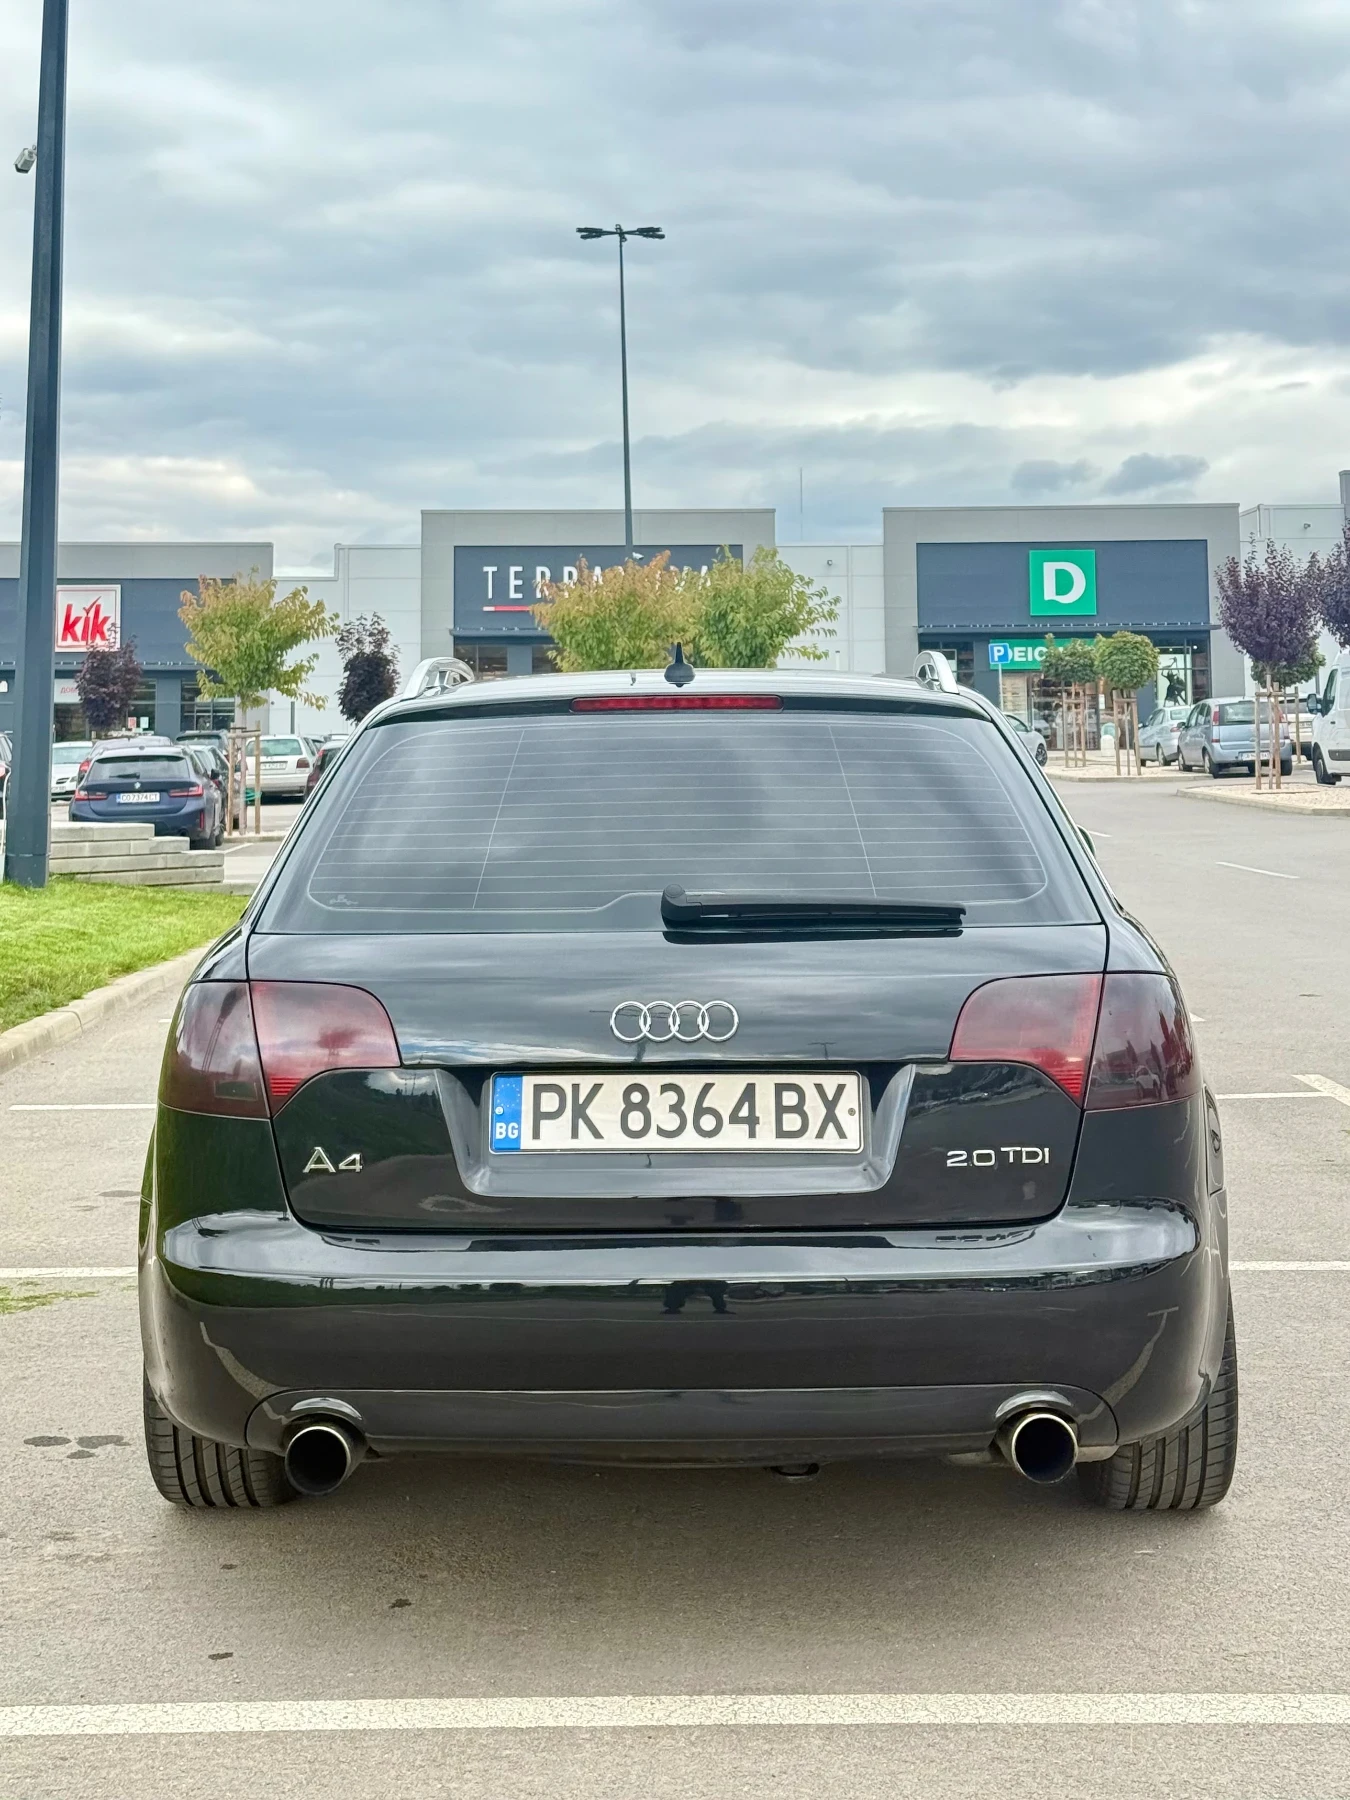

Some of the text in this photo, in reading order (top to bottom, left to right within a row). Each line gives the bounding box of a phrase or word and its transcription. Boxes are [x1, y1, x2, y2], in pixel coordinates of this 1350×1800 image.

[1043, 561, 1087, 605] D
[61, 596, 111, 646] kik
[993, 646, 1005, 662] P
[532, 1082, 848, 1140] PK 8364 BX
[495, 1122, 519, 1140] BG
[302, 1146, 363, 1173] A4
[946, 1146, 1050, 1168] 2.0 TDI
